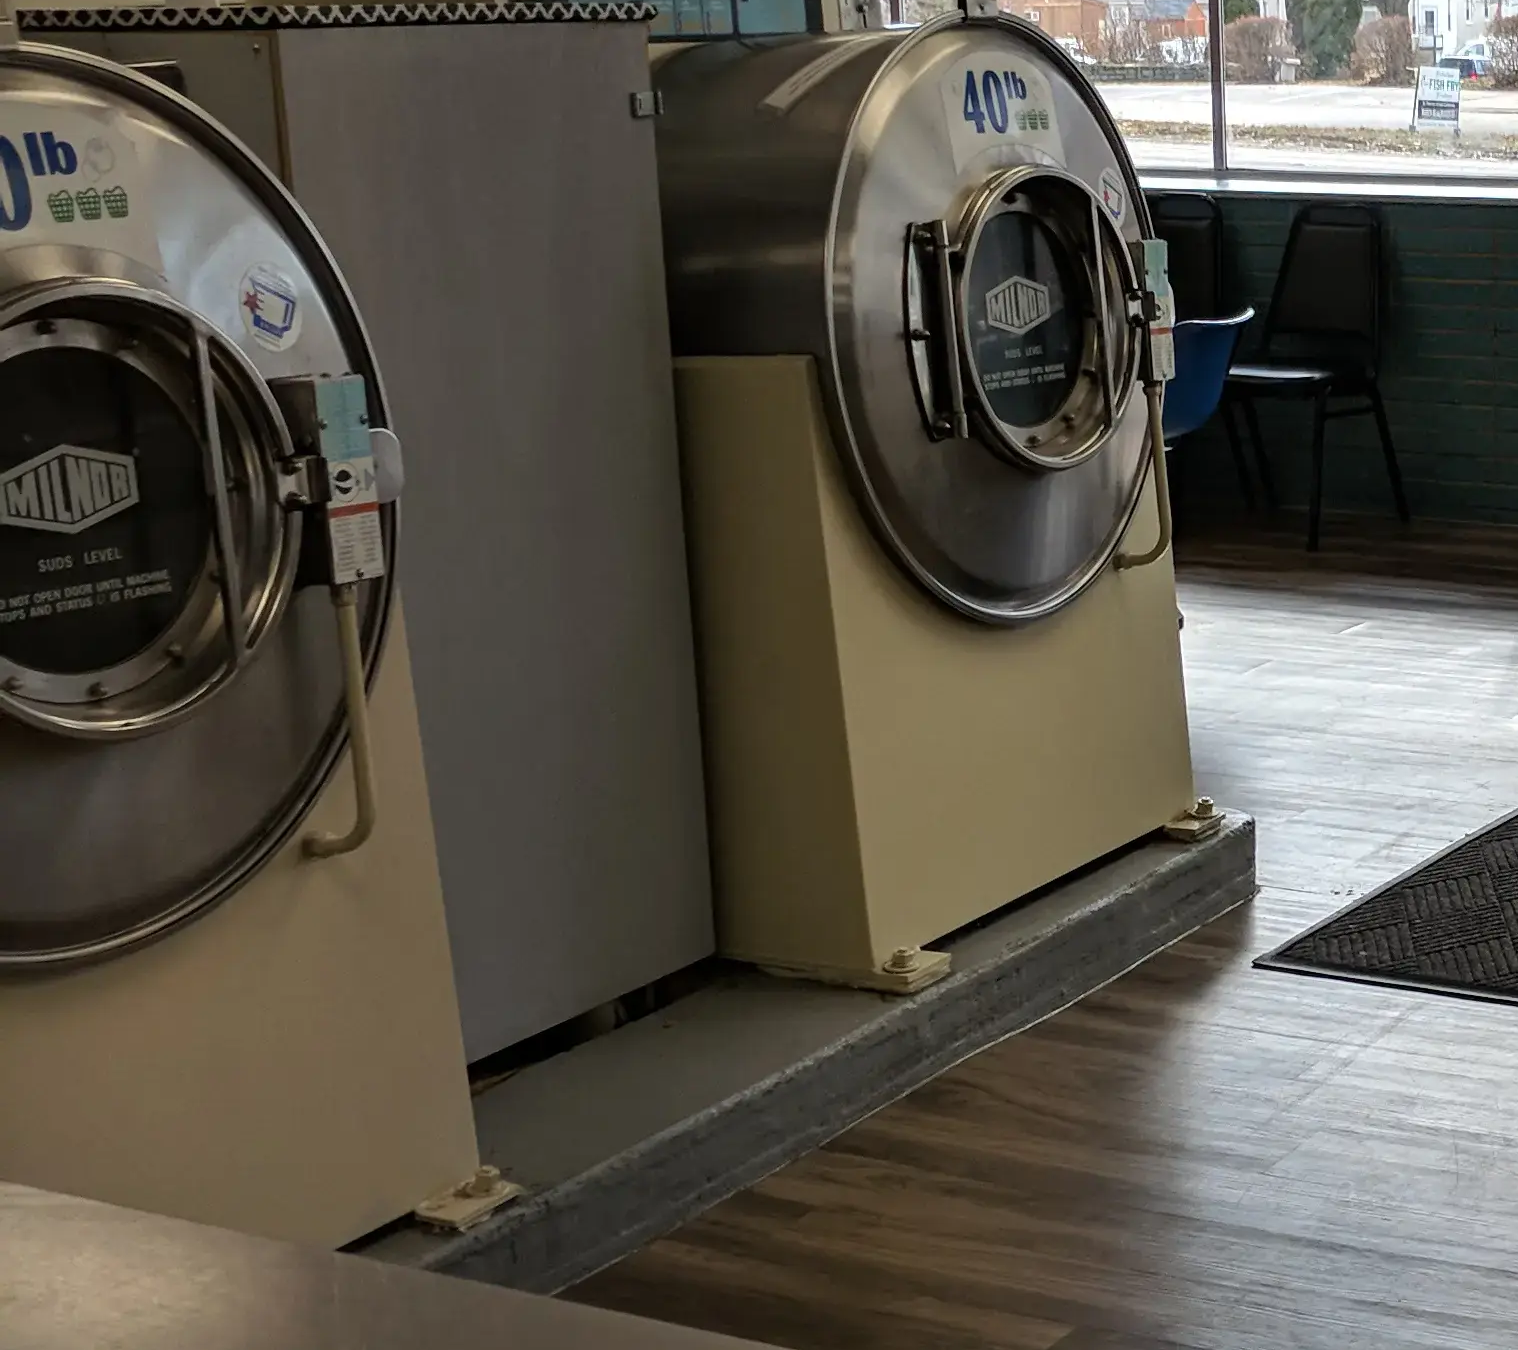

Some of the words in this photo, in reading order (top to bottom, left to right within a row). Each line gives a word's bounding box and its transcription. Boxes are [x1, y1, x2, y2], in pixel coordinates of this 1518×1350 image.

[4, 453, 131, 524] MILNOR
[37, 555, 73, 573] SUDS
[83, 547, 123, 565] LEVEL
[9, 594, 31, 608] NOT
[33, 589, 61, 604] OPEN
[64, 583, 93, 598] DOOR
[30, 604, 52, 617] AND
[56, 596, 93, 613] STATUS
